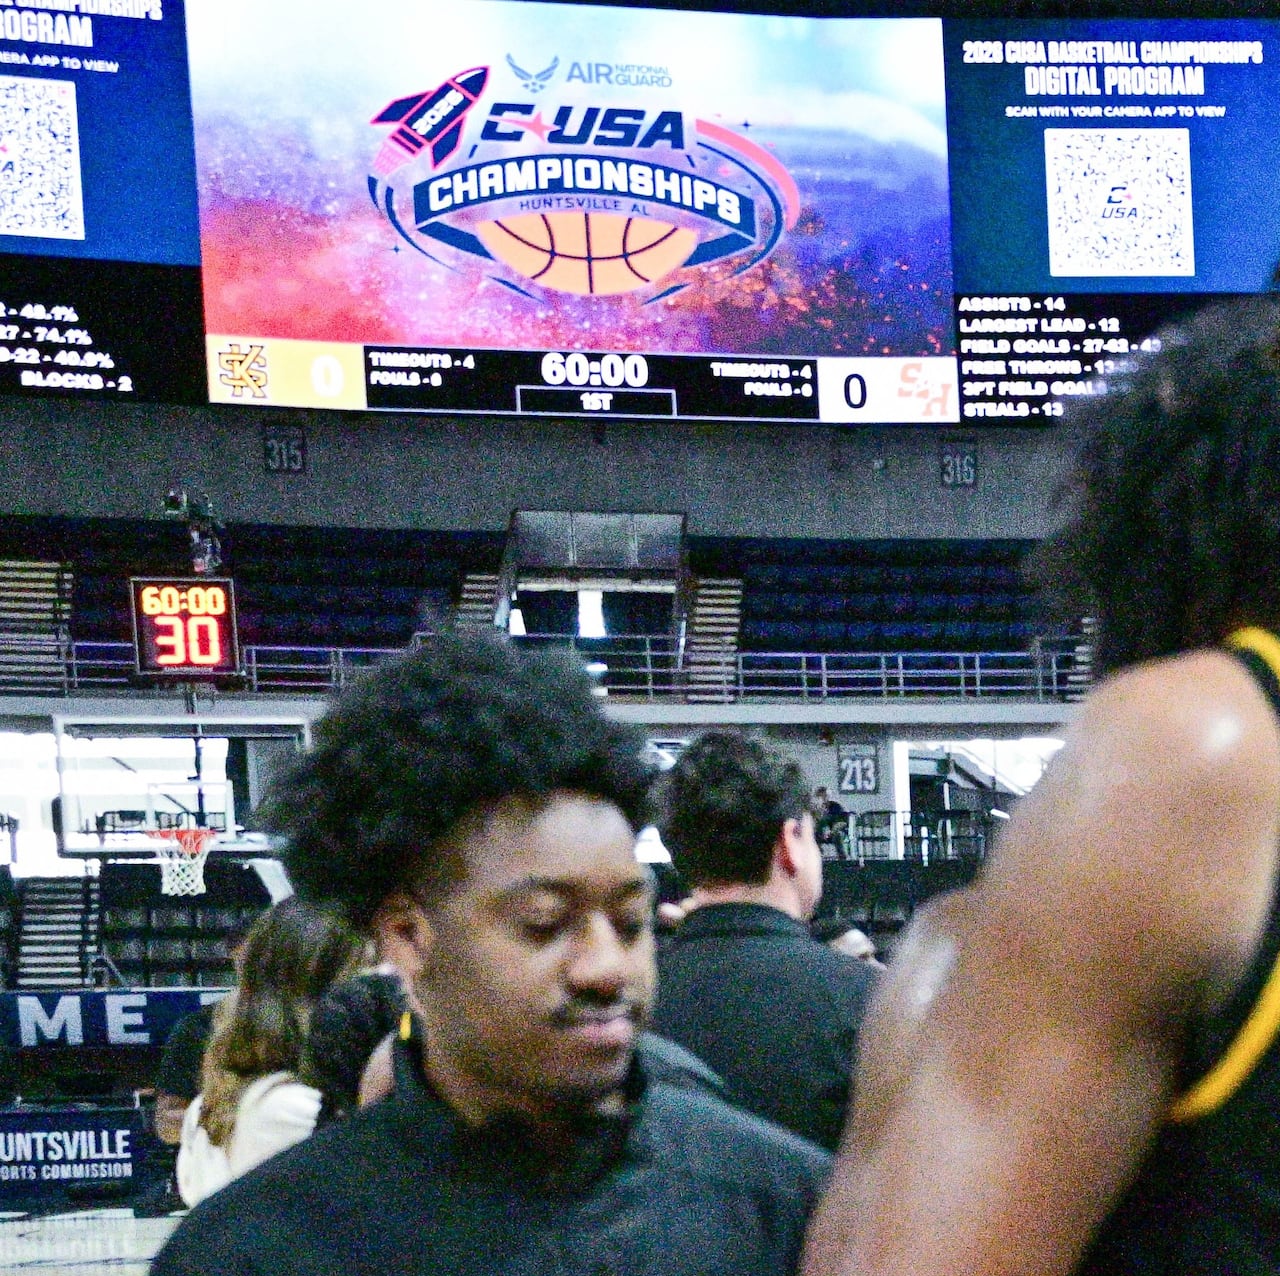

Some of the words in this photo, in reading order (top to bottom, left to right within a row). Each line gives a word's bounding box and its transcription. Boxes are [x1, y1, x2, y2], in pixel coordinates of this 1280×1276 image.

[1004, 40, 1047, 64] CUSA
[1048, 40, 1140, 64] BASKETBALL
[1140, 40, 1264, 64] CHAMPIONSHIPS
[61, 57, 82, 70] TO
[83, 59, 119, 73] VIEW
[566, 61, 614, 85] AIR
[615, 63, 670, 76] NATIONAL
[615, 74, 673, 88] GUARD
[1024, 65, 1102, 96] DIGITAL
[1103, 65, 1206, 96] PROGRAM
[1004, 106, 1038, 118] SCAN
[1039, 106, 1070, 118] WITH
[1070, 106, 1103, 118] YOUR
[1103, 106, 1153, 118] CAMERA
[1153, 106, 1177, 118] APP
[1177, 106, 1195, 118] TO
[1195, 106, 1227, 118] VIEW
[429, 156, 742, 224] CHAMPIONSHIPS
[520, 195, 623, 211] HUNTSVILLE
[631, 203, 650, 216] AL
[959, 297, 1031, 312] ASSISTS
[1043, 297, 1066, 311] 14
[960, 318, 1038, 333] LARGEST
[1041, 318, 1086, 333] LEAD
[1098, 317, 1120, 332] 12
[961, 339, 1011, 353] FIELD
[1013, 339, 1071, 353] GOALS
[369, 352, 452, 368] TIMEOUTS
[463, 354, 475, 369] 4
[540, 351, 650, 388] 60:00
[962, 360, 1007, 374] FREE
[1008, 360, 1082, 375] THROWS
[310, 354, 345, 399] 0
[369, 371, 421, 386] FOULS
[710, 361, 791, 379] TIMEOUTS
[800, 364, 813, 379] 4
[21, 370, 104, 390] BLOCKS
[117, 375, 133, 392] 2
[743, 382, 793, 397] FOULS
[998, 381, 1049, 396] FIELD
[843, 372, 868, 409] 0
[579, 392, 614, 411] 1ST
[963, 402, 1030, 417] STEALS
[141, 586, 226, 615] 60:00
[154, 615, 221, 665] 30
[840, 758, 876, 791] 213
[41, 1162, 133, 1180] COMMISSION
